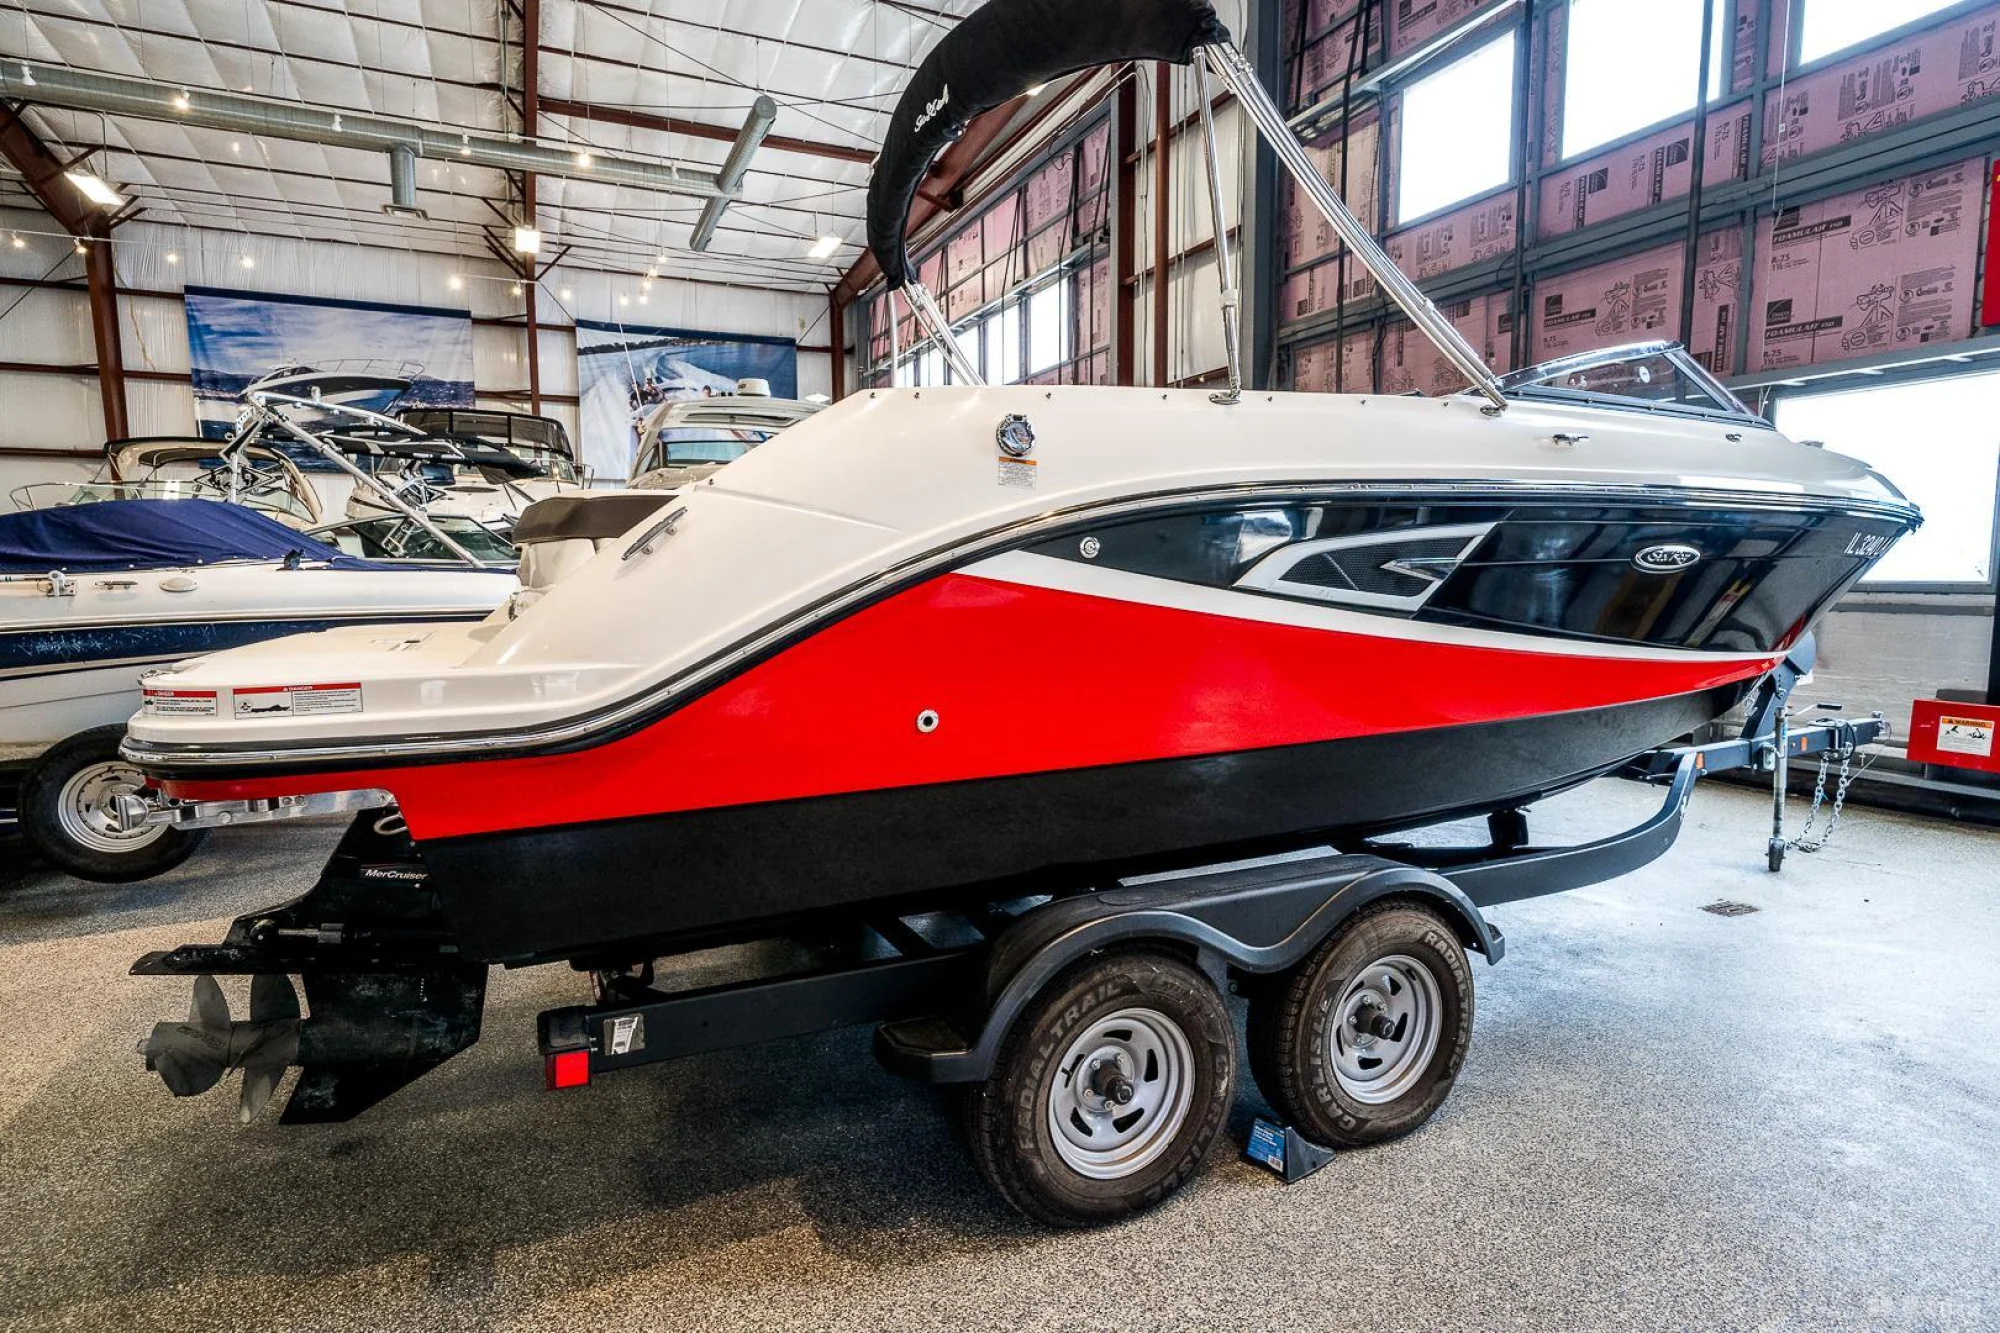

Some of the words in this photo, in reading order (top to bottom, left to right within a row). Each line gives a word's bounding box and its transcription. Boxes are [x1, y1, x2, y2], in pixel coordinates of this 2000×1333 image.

[1955, 719, 1986, 728] WARNING
[365, 869, 429, 879] MerCruiser
[1424, 931, 1467, 998] RADIAL
[1018, 1043, 1055, 1151] RADIAL
[1054, 983, 1123, 1038] TRAIL
